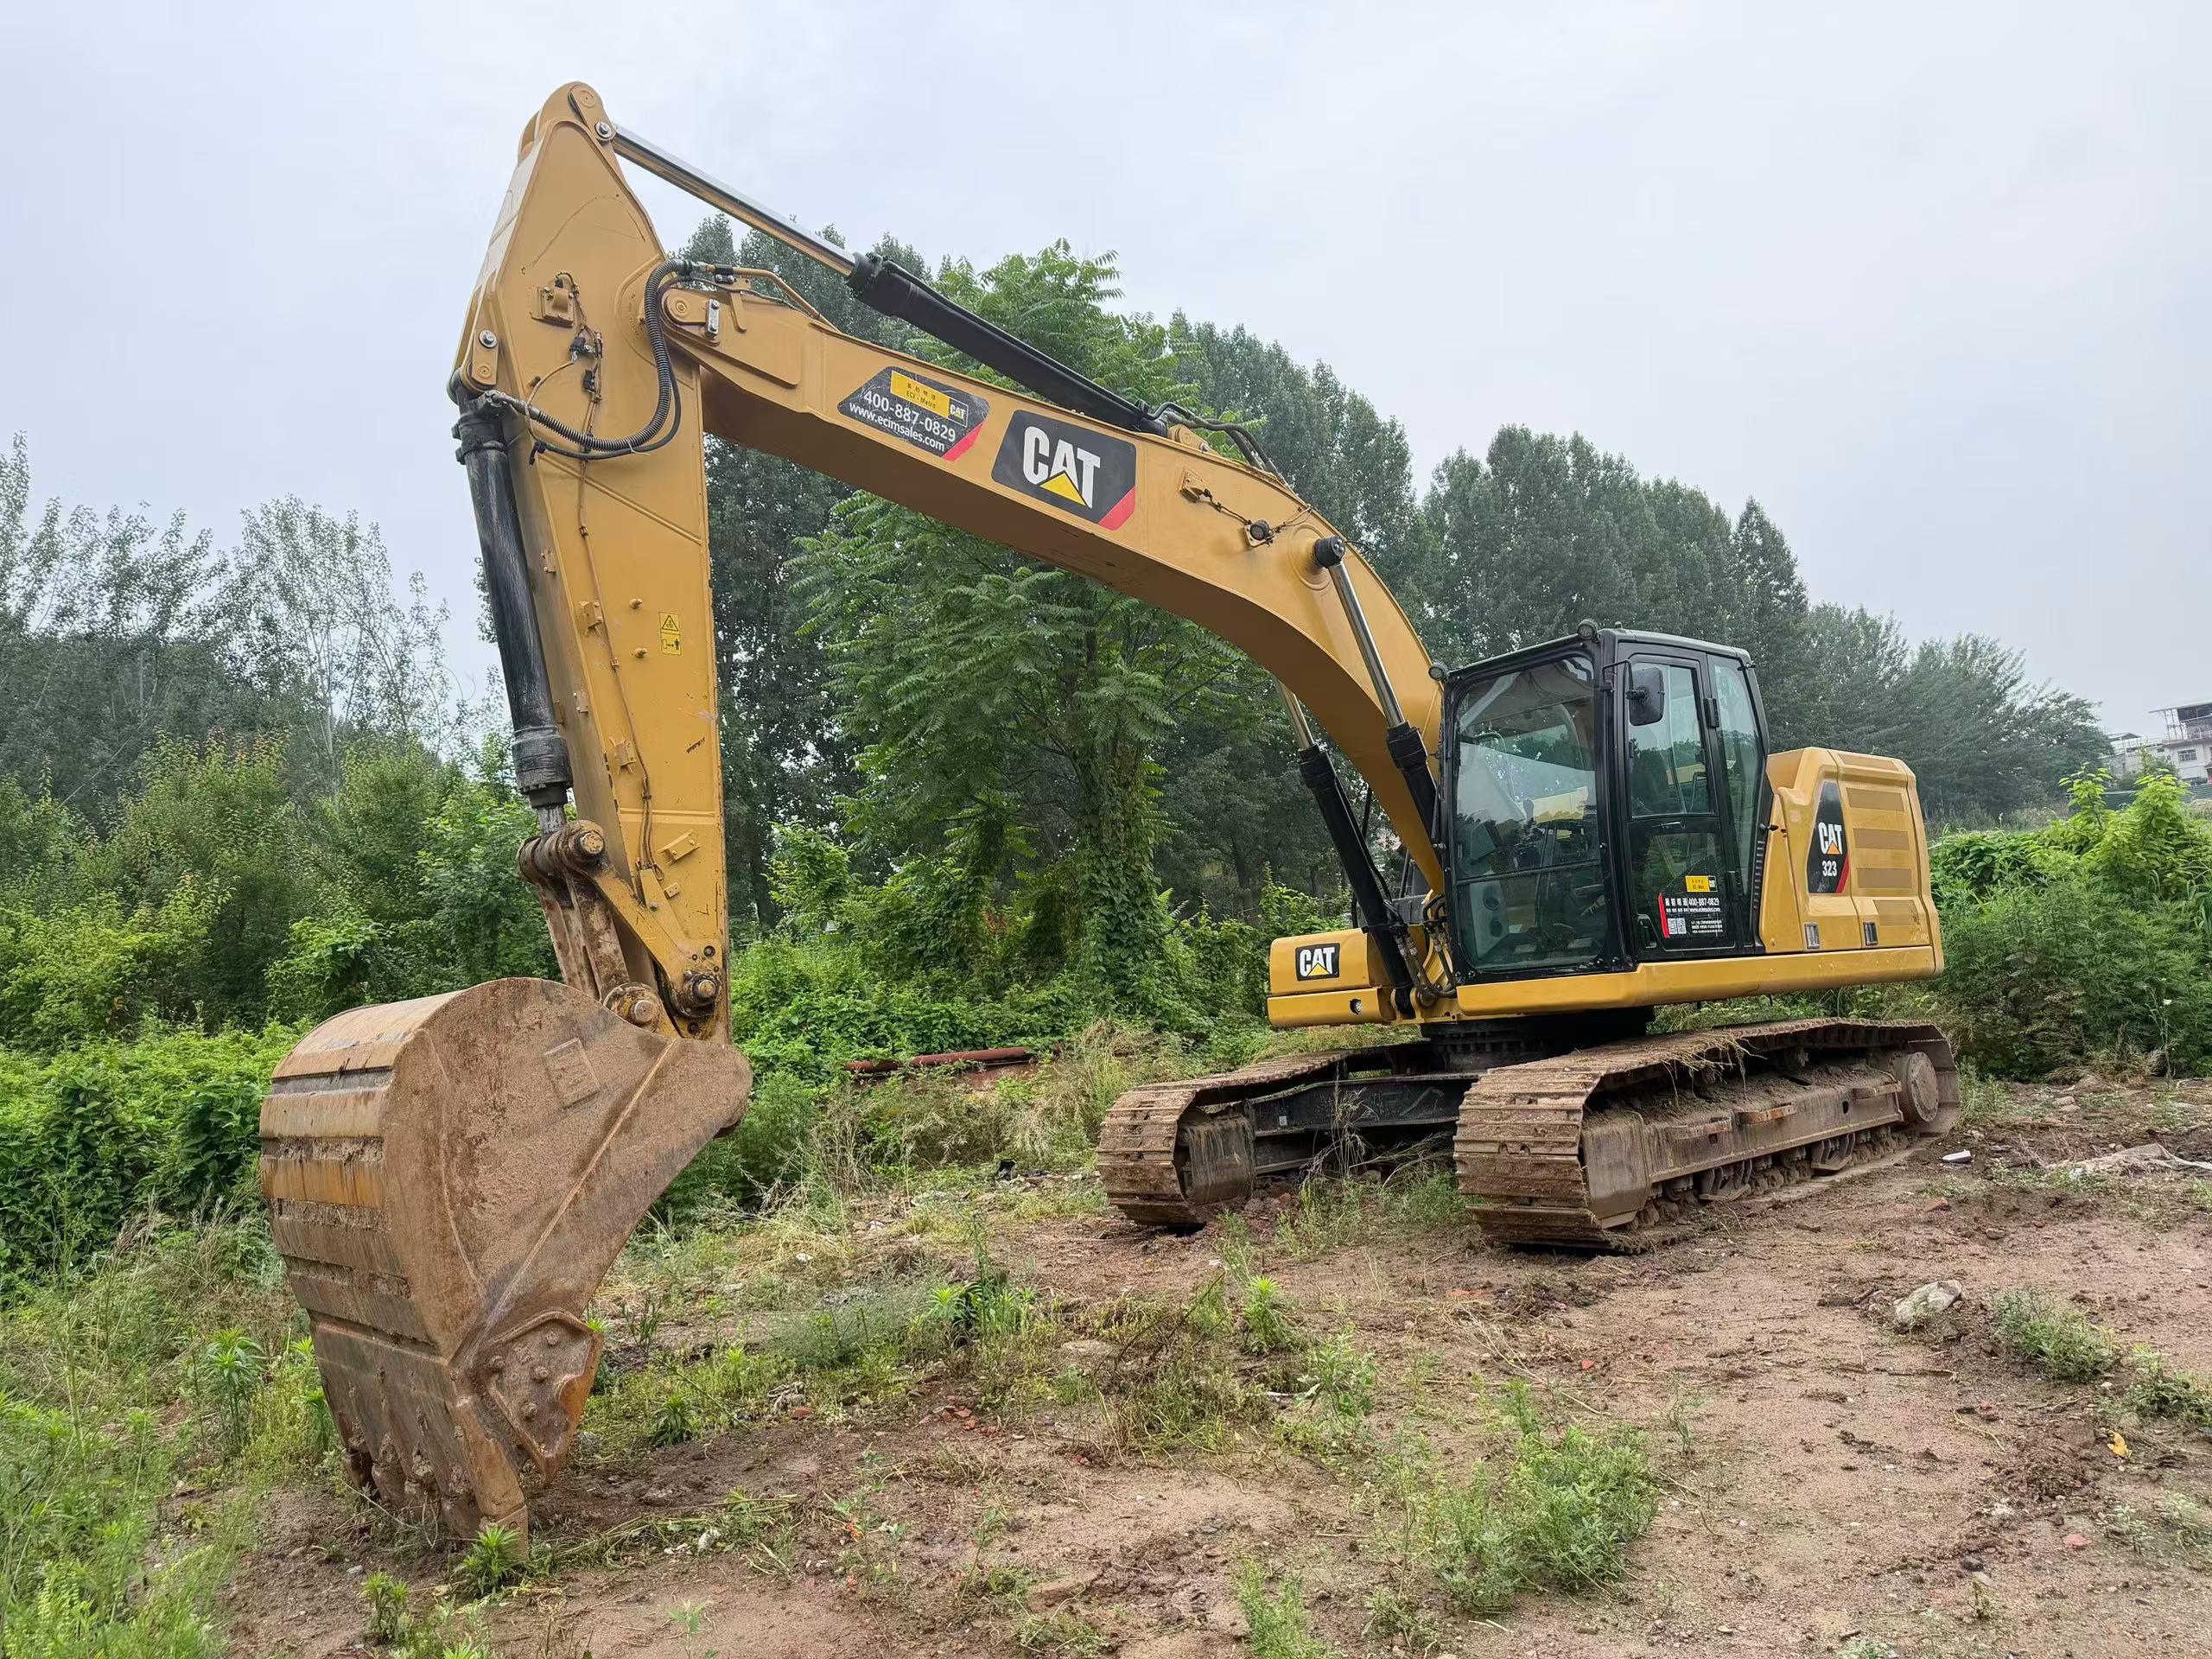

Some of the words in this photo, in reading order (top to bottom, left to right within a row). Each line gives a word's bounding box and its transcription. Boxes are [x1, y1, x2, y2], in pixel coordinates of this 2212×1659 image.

[849, 402, 945, 452] www.ecimsales.com
[864, 390, 956, 442] 400-887-0829
[950, 404, 966, 420] CAT
[1022, 426, 1101, 509] CAT
[1818, 822, 1843, 855] CAT
[1821, 861, 1838, 877] 323
[1300, 946, 1335, 976] CAT
